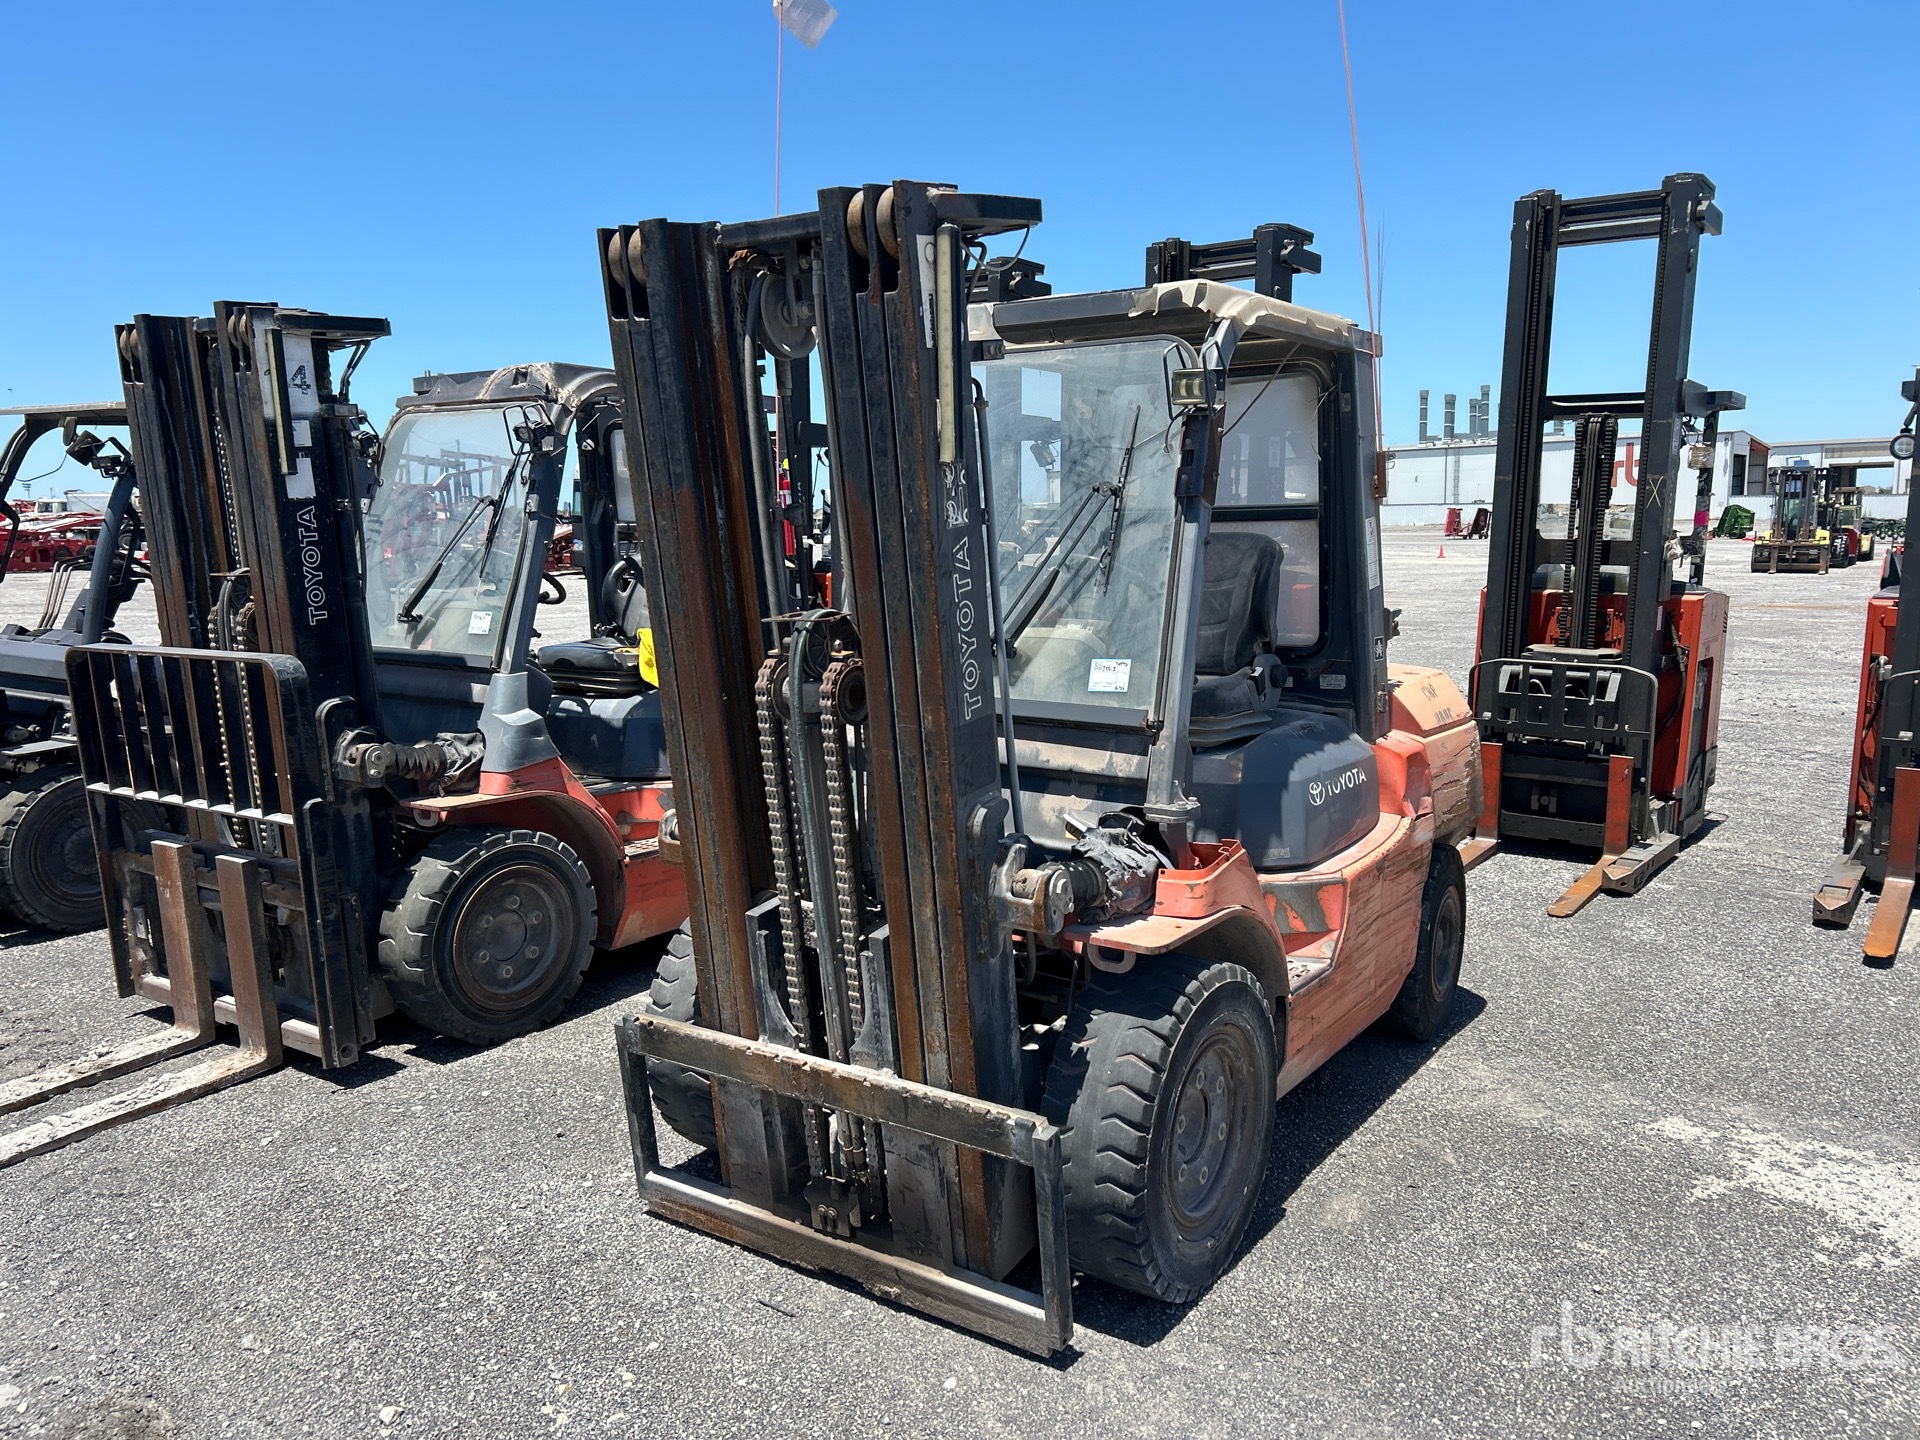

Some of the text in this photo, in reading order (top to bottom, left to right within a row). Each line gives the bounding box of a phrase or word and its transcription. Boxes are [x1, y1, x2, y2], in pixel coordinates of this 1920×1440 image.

[288, 364, 312, 395] 4
[296, 504, 328, 626] TOYOTA
[952, 535, 982, 721] TOYOTA
[1324, 767, 1367, 796] TOYOTA
